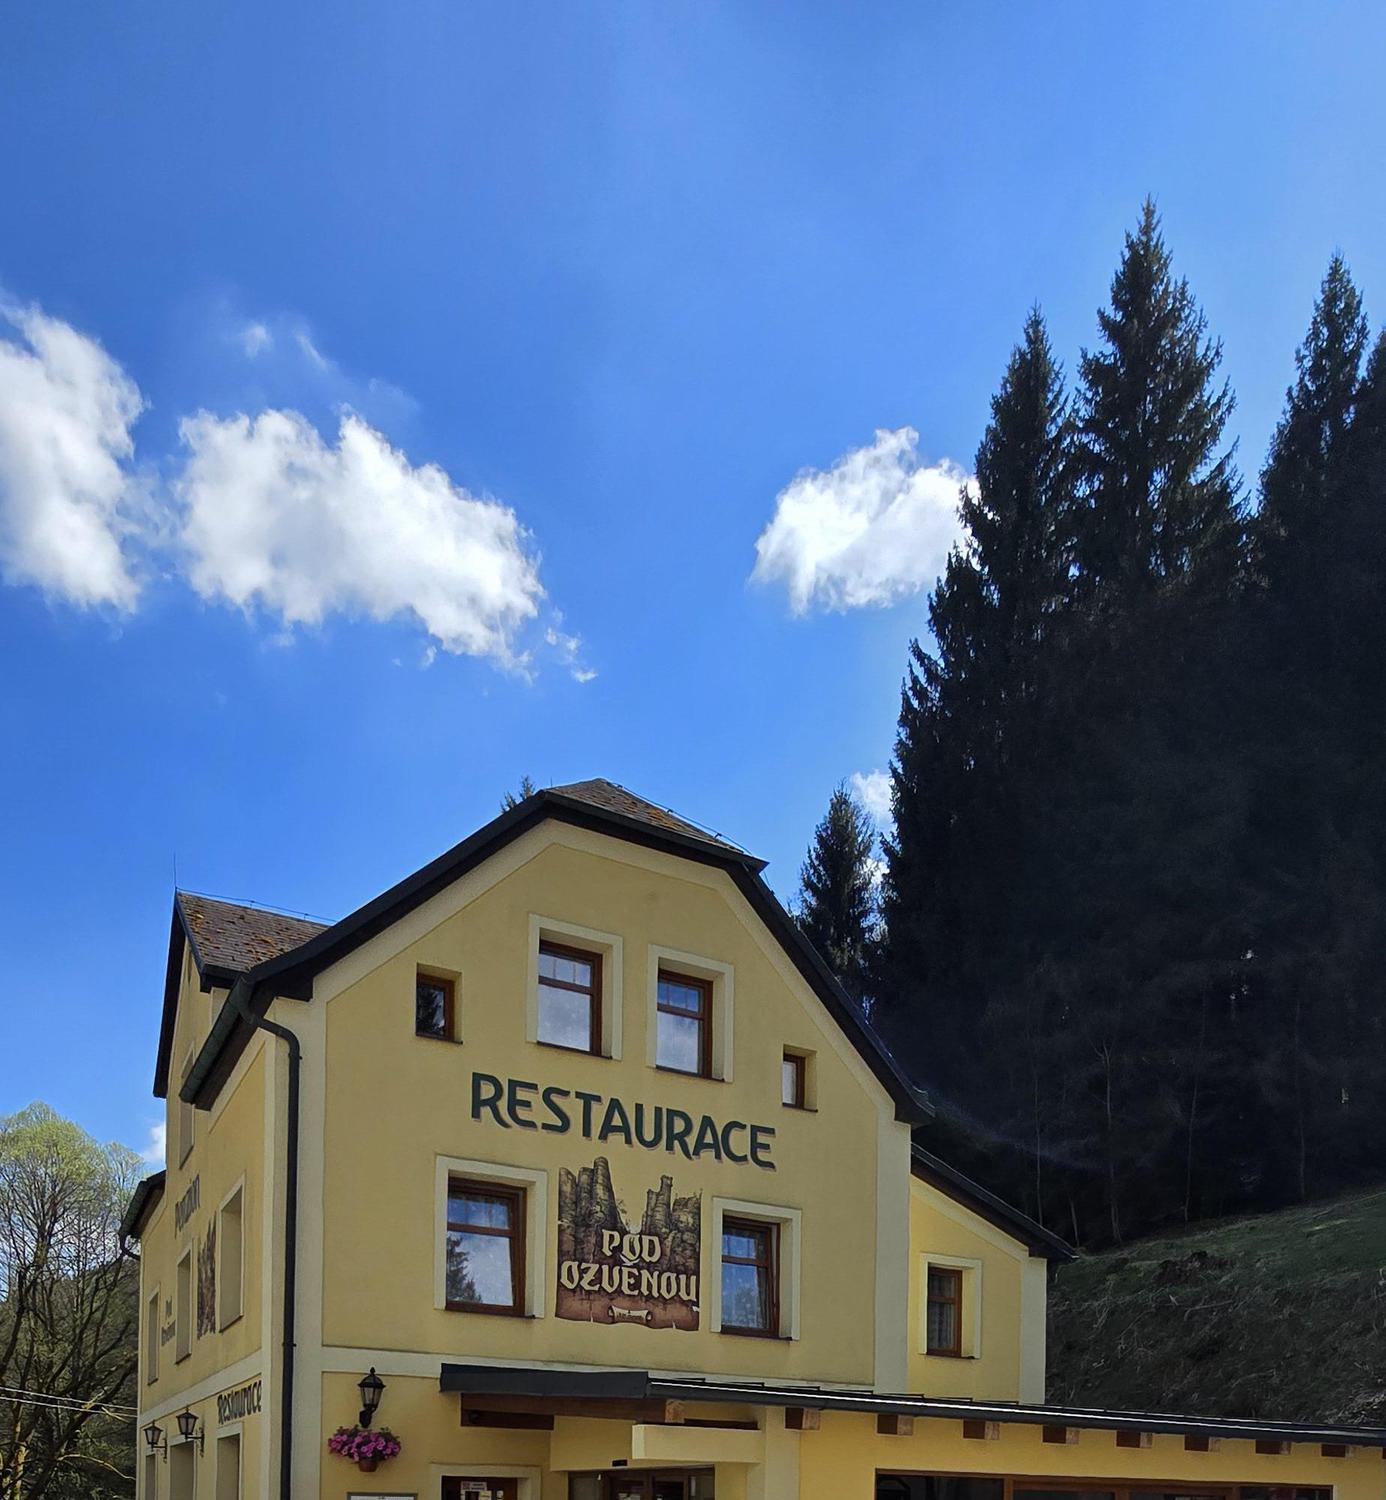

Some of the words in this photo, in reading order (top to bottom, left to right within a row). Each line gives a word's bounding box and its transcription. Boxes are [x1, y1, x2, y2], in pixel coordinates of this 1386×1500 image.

[471, 1072, 776, 1169] RESTAURACE
[601, 1229, 662, 1263] POD
[560, 1257, 697, 1301] OZVĚNOU
[217, 1380, 262, 1424] Restaurace
